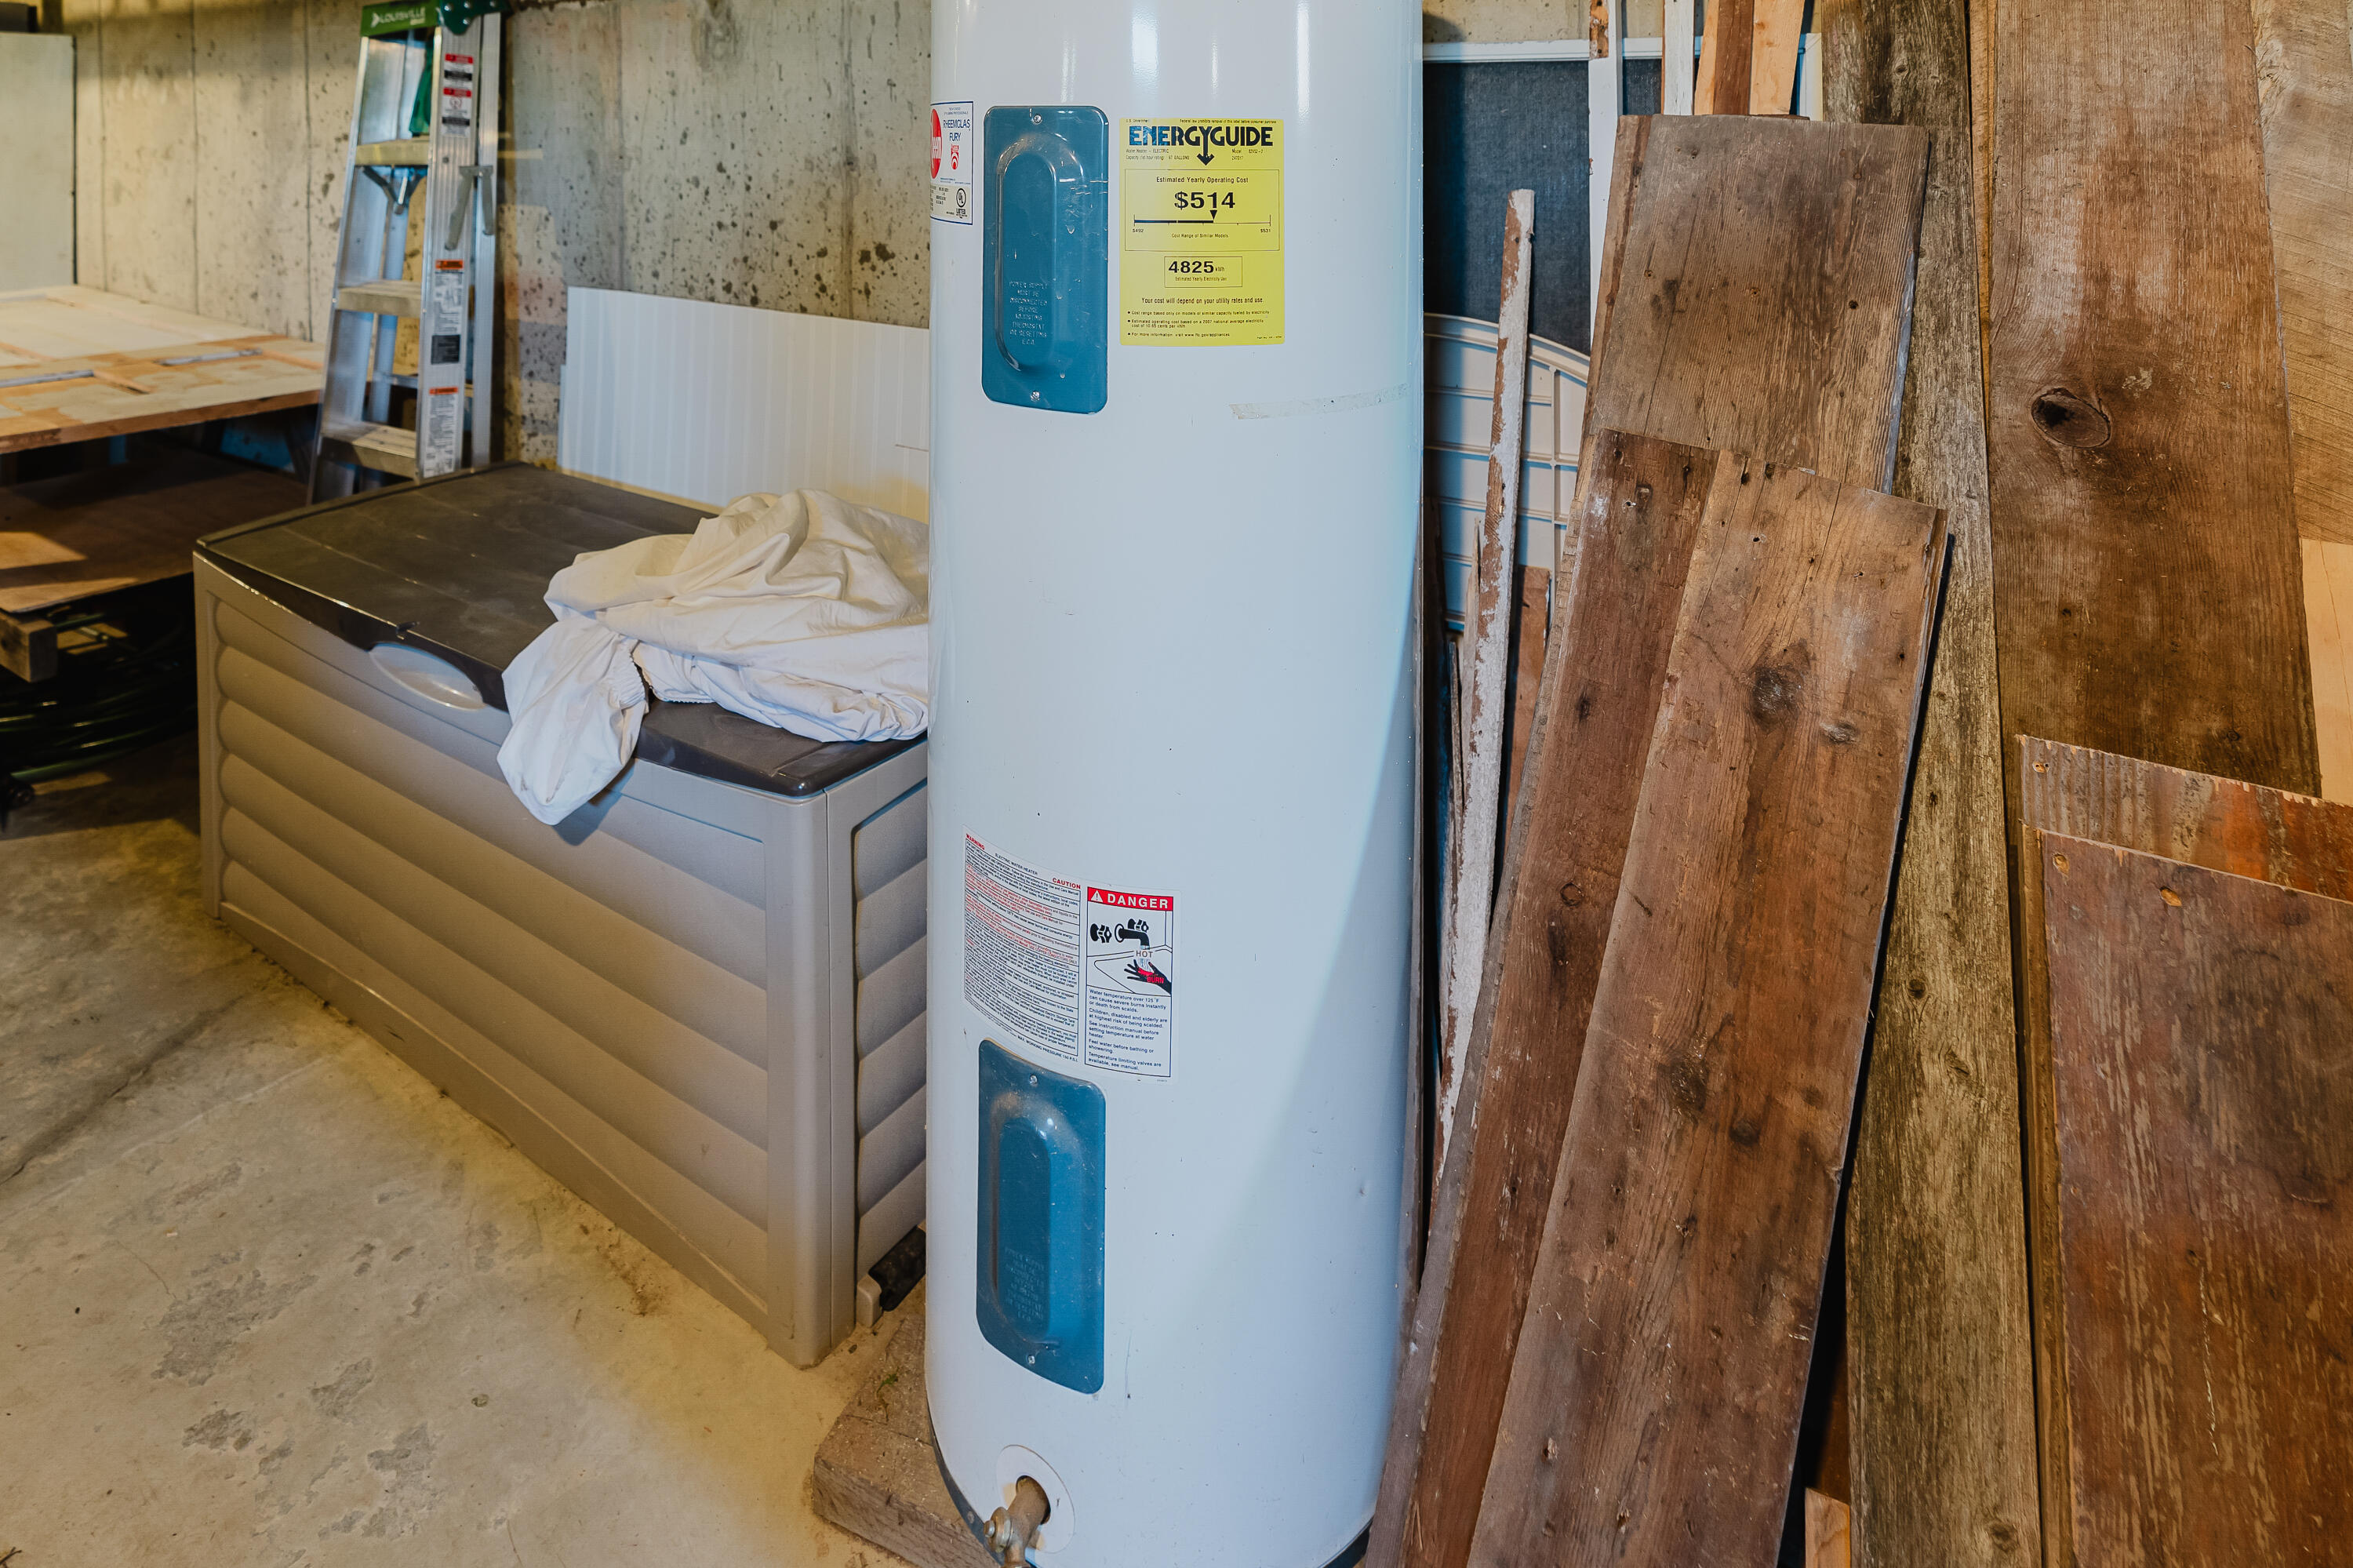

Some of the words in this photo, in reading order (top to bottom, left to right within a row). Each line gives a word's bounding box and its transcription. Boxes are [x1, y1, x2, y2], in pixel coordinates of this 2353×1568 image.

[949, 133, 961, 141] FURY
[1129, 126, 1273, 147] ENERGYGUIDE
[1174, 191, 1235, 210] $514
[1169, 261, 1214, 273] 4825
[1024, 867, 1038, 875] HEATER
[1053, 877, 1081, 890] CAUTION
[1107, 893, 1168, 908] DANGER
[1104, 992, 1132, 1001] temperature
[1106, 1029, 1133, 1038] temperature
[1026, 1040, 1042, 1050] WORKING
[1043, 1048, 1061, 1057] PRESSURE
[1089, 1052, 1117, 1061] Temperature
[1089, 1057, 1110, 1066] available,
